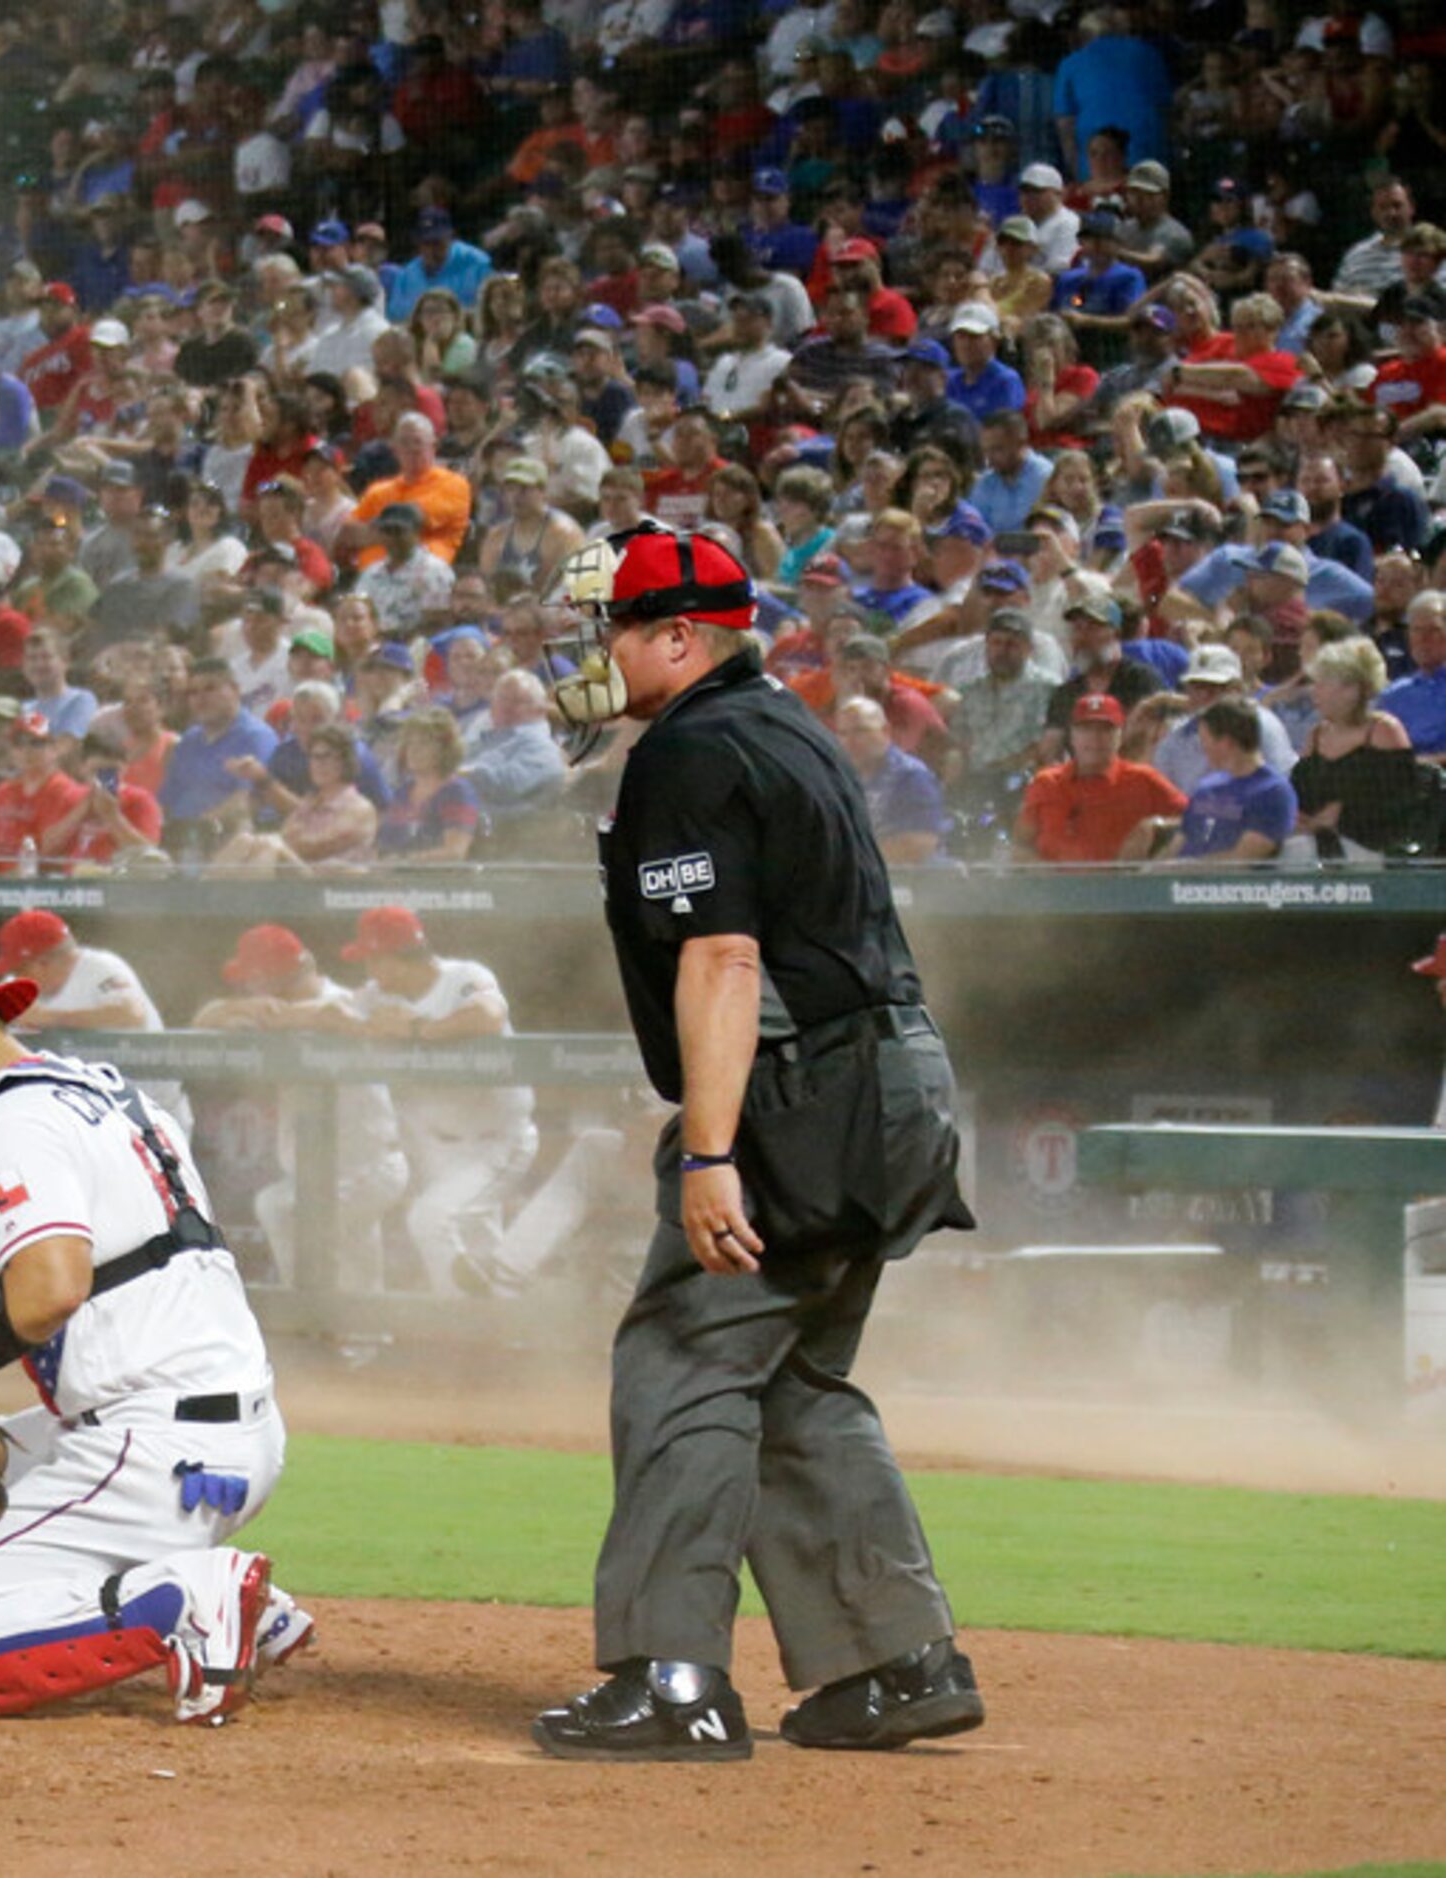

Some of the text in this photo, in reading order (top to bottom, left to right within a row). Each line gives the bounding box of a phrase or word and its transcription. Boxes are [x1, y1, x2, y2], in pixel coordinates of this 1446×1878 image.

[645, 860, 711, 891] DH BE
[1171, 881, 1373, 909] texasrangers.com
[689, 1708, 728, 1741] N
